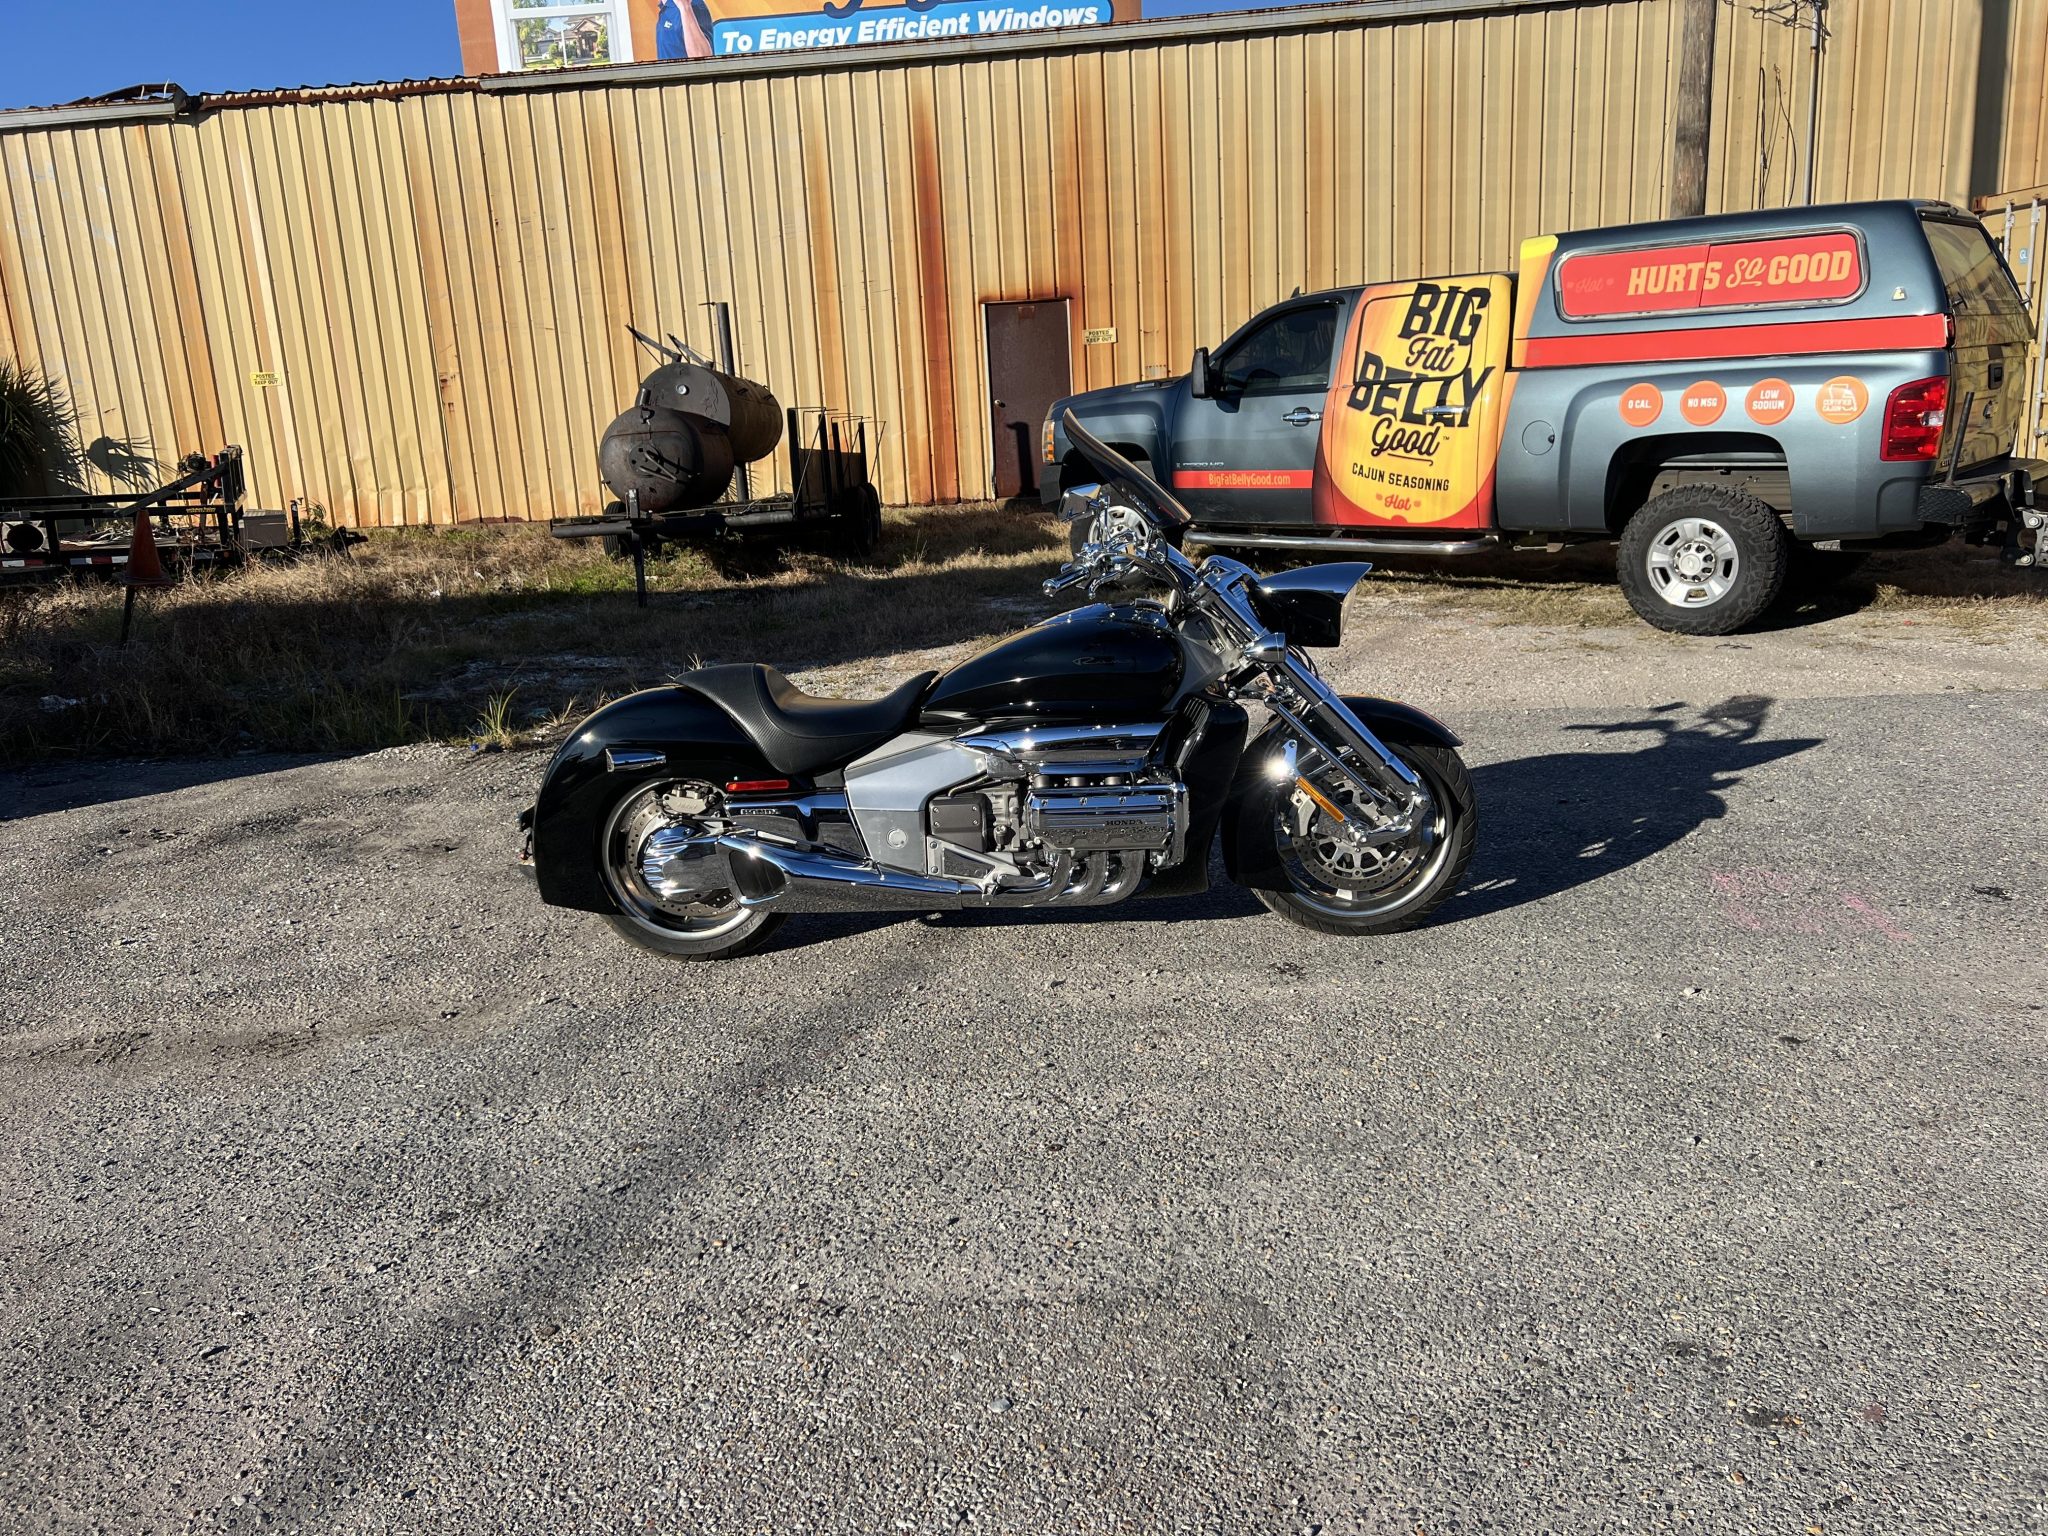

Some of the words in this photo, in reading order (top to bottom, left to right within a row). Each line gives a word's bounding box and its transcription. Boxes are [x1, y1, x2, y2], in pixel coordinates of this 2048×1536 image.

[722, 31, 753, 53] To
[759, 26, 852, 51] Energy
[857, 17, 970, 43] Efficient
[978, 5, 1098, 32] Windows
[1626, 261, 1723, 296] HURTS
[1767, 250, 1852, 283] GOOD
[1397, 283, 1491, 346] BIG
[1405, 337, 1457, 371] Fat
[1347, 351, 1496, 428] BELLY
[1688, 399, 1699, 408] NO
[1701, 398, 1718, 408] MSG
[1752, 400, 1785, 410] SODIUM
[1760, 389, 1780, 400] LOW
[1371, 417, 1441, 458] Good
[1208, 473, 1291, 487] BigFatBellyGood.com
[1352, 462, 1385, 483] CAJUN
[1388, 472, 1450, 491] SEASONING
[1384, 493, 1412, 511] Hot
